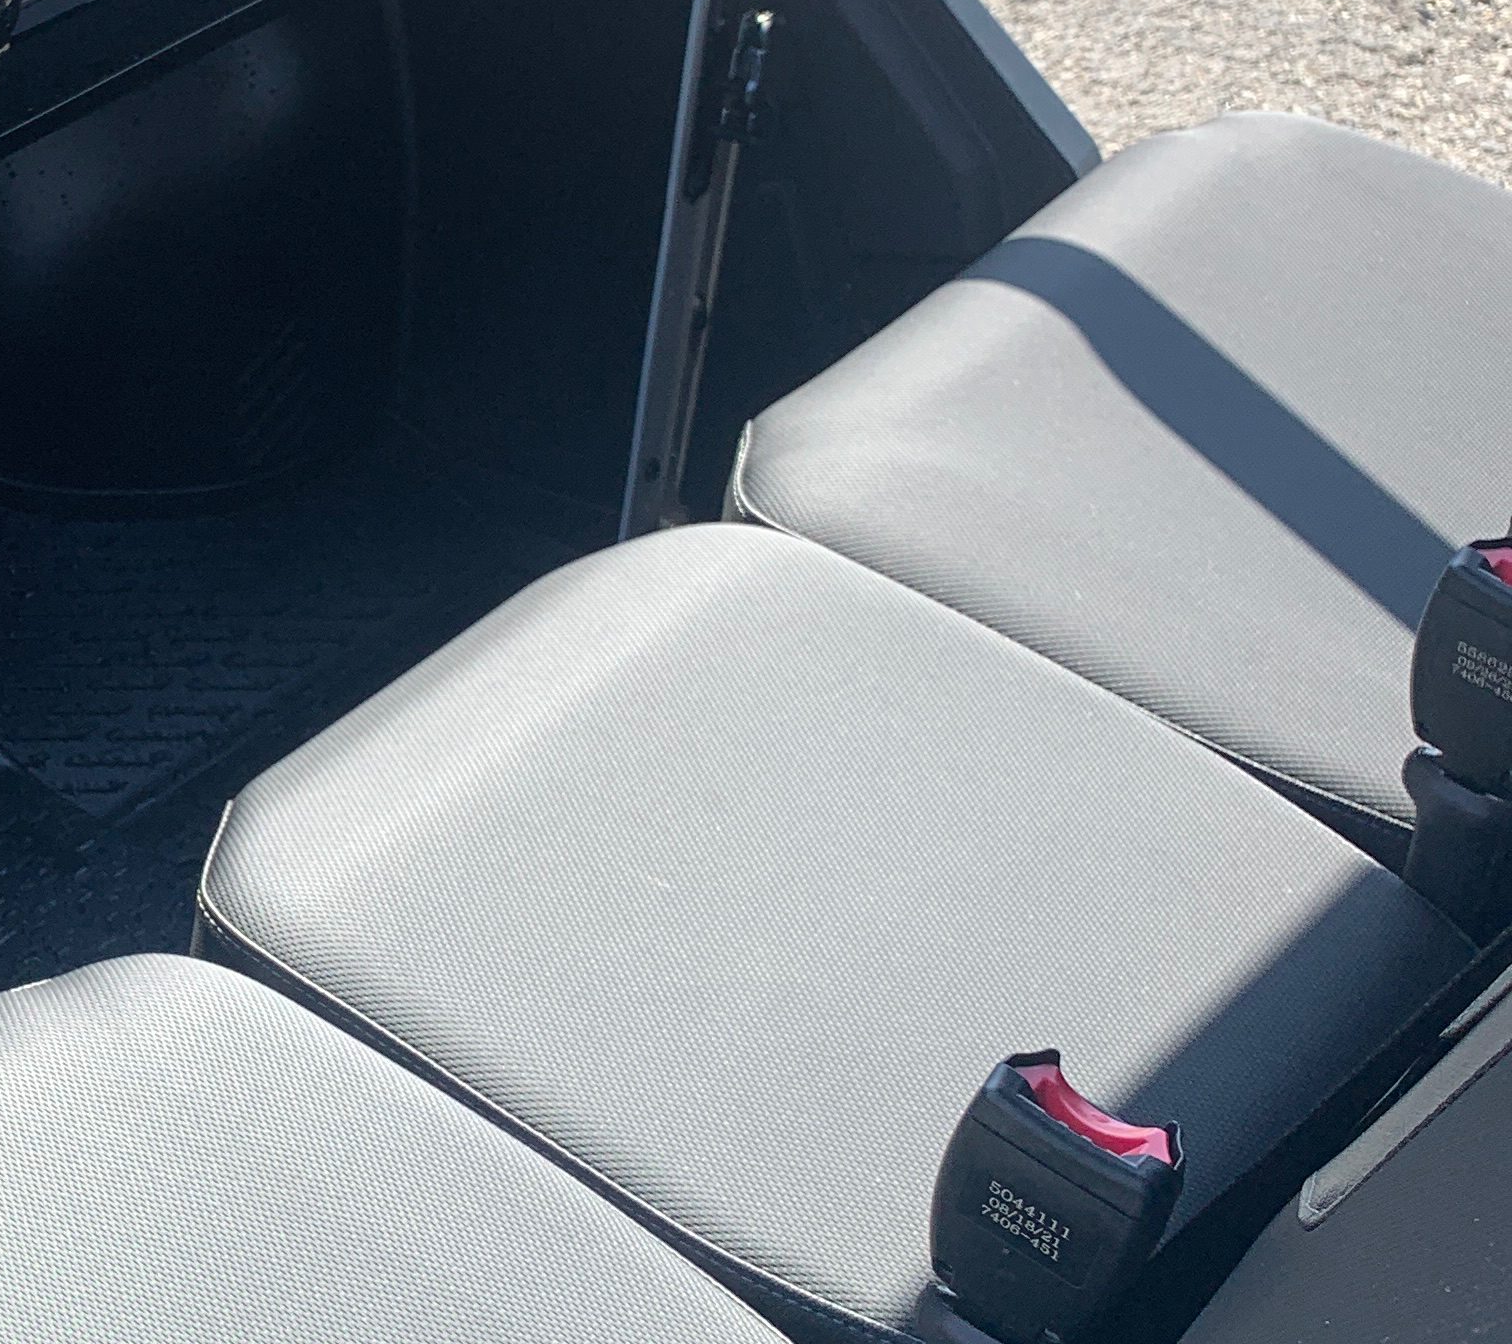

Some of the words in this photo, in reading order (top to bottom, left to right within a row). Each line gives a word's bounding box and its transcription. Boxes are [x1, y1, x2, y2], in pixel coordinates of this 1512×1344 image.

[981, 1204, 1061, 1262] 7406-451
[988, 1180, 1071, 1241] 5044111
[988, 1196, 1061, 1249] 08/18/21
